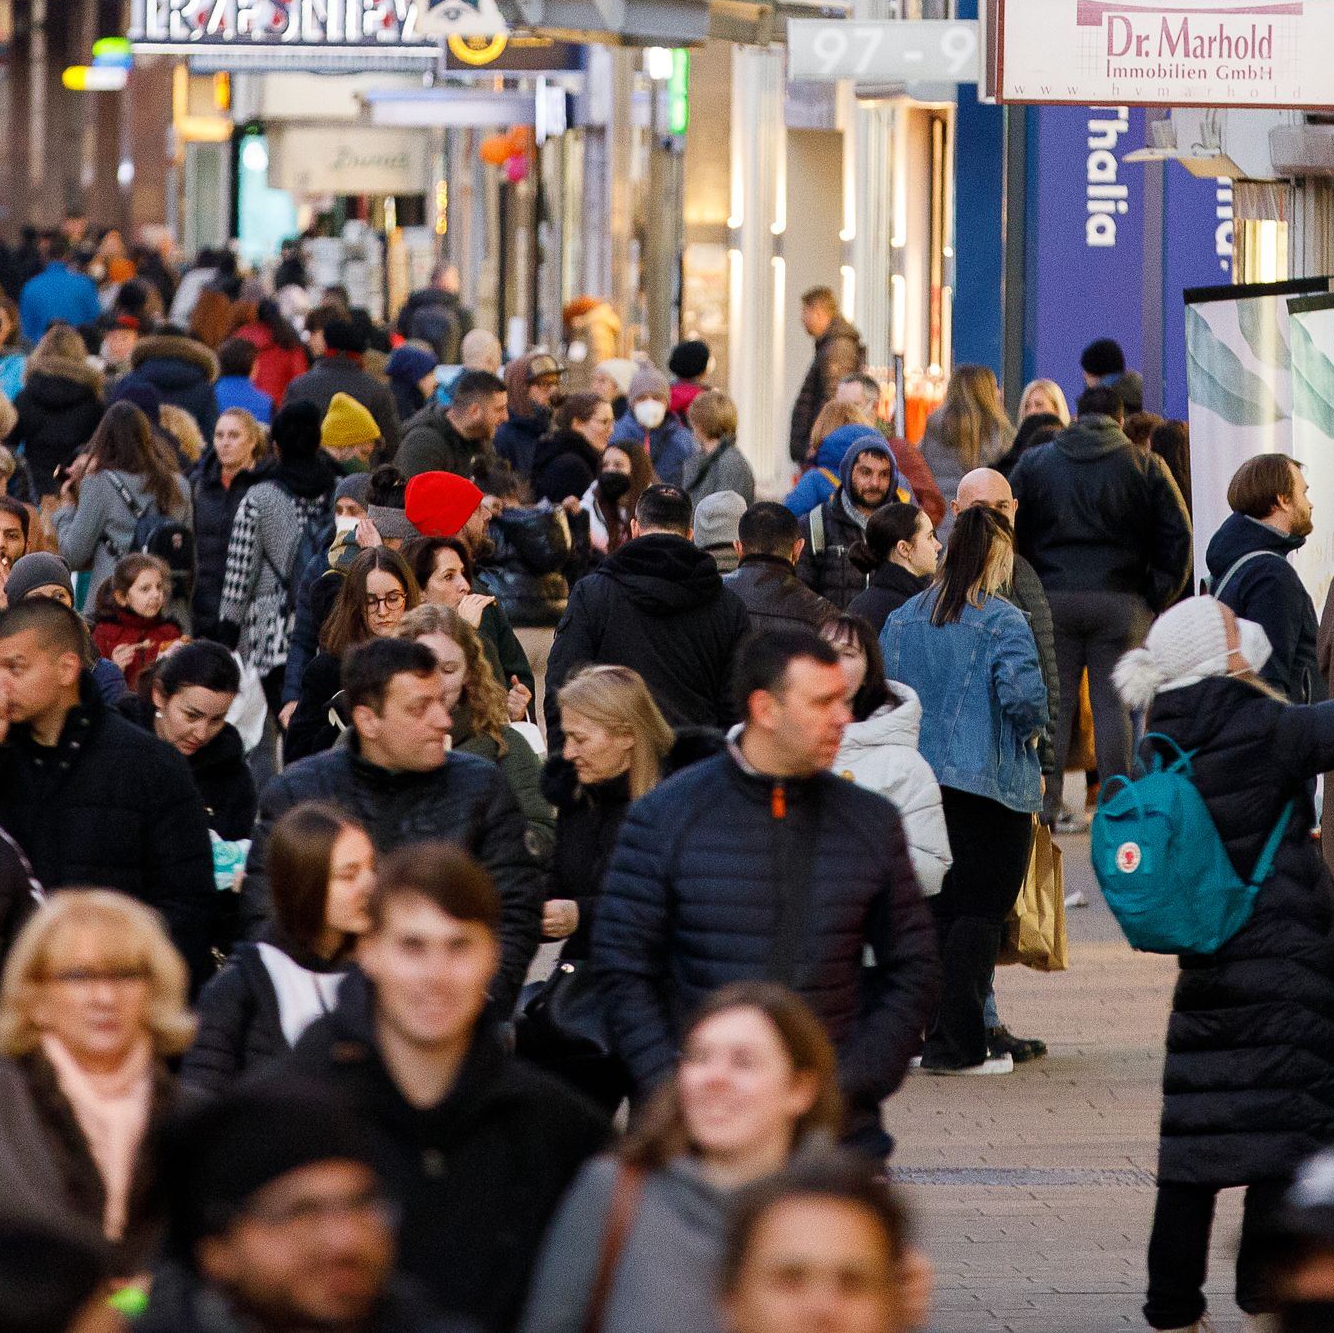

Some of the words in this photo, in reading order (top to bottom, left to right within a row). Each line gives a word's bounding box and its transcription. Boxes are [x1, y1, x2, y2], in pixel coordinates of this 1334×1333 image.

[1107, 15, 1150, 58] Dr.
[1158, 16, 1273, 60] Marhold
[1107, 59, 1208, 80] Immobilien
[1217, 65, 1273, 81] GmbH
